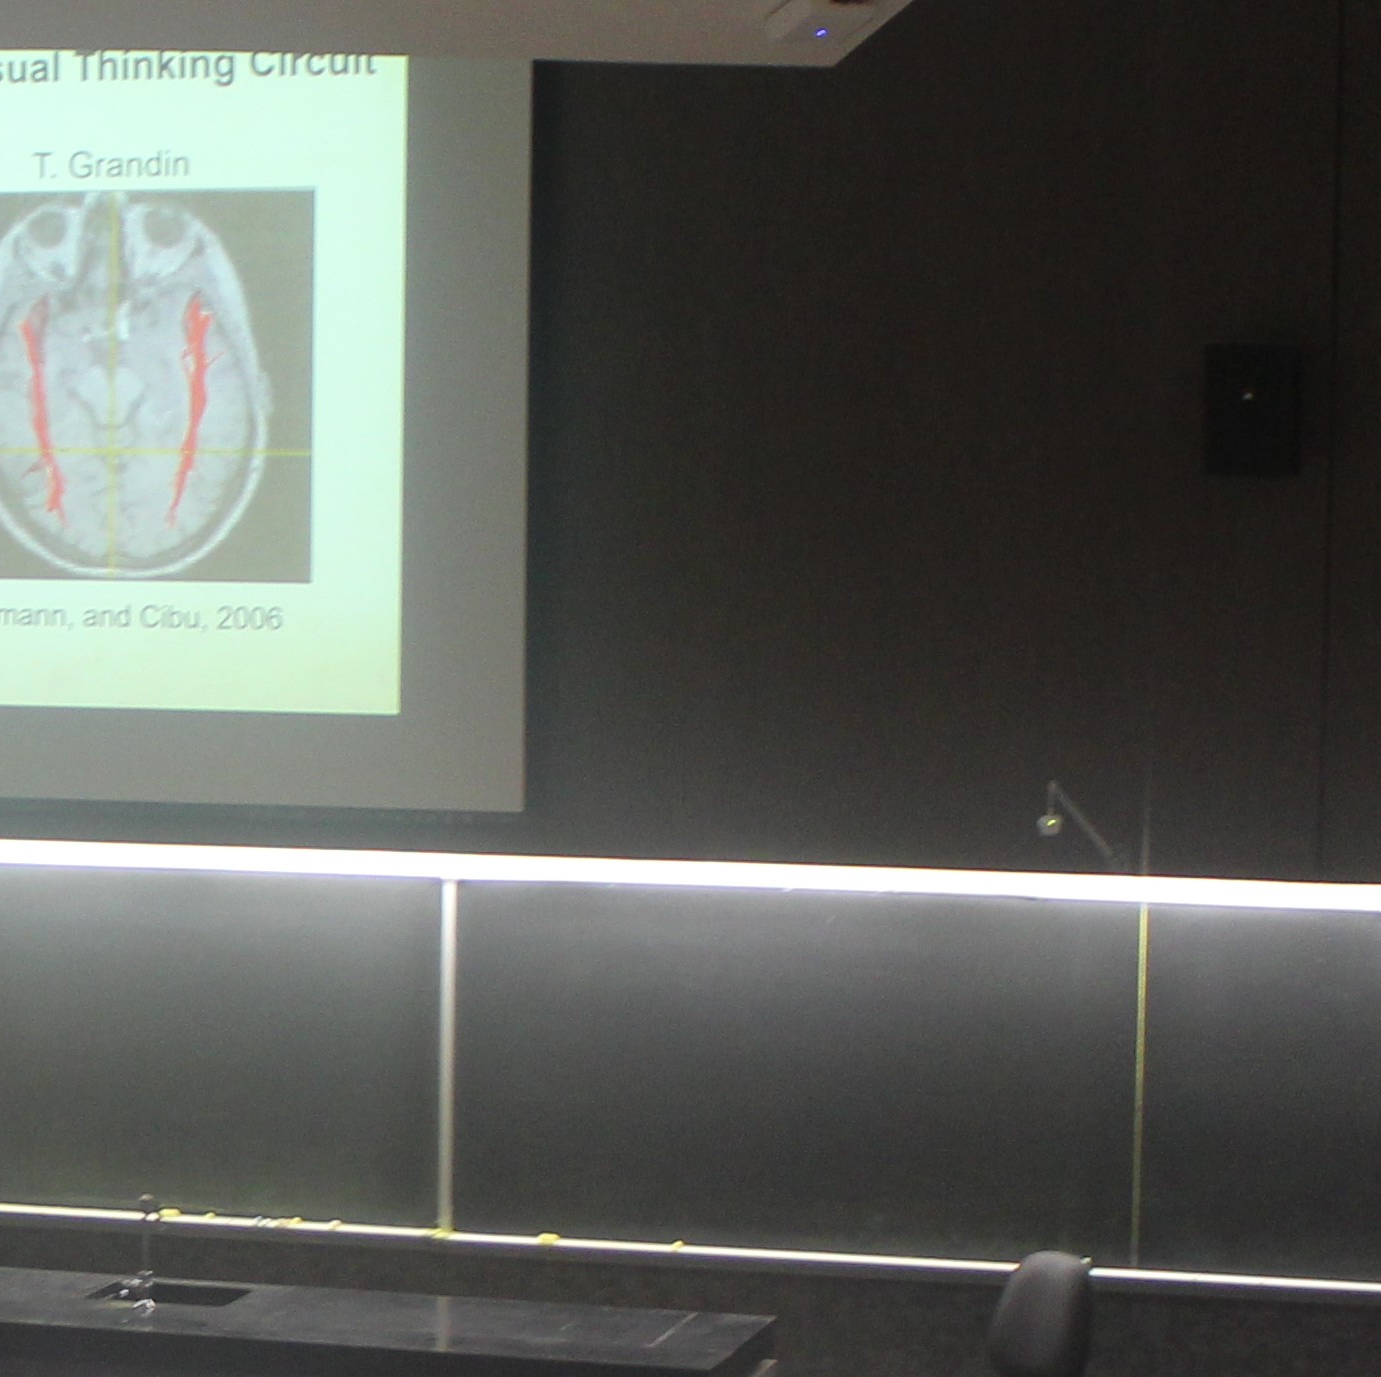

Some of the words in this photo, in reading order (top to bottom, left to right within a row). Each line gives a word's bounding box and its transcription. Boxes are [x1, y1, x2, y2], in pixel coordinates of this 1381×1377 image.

[76, 49, 235, 87] Thinking
[33, 152, 57, 179] T.
[68, 150, 191, 179] Grandin
[82, 604, 131, 628] and
[216, 605, 284, 630] 2006
